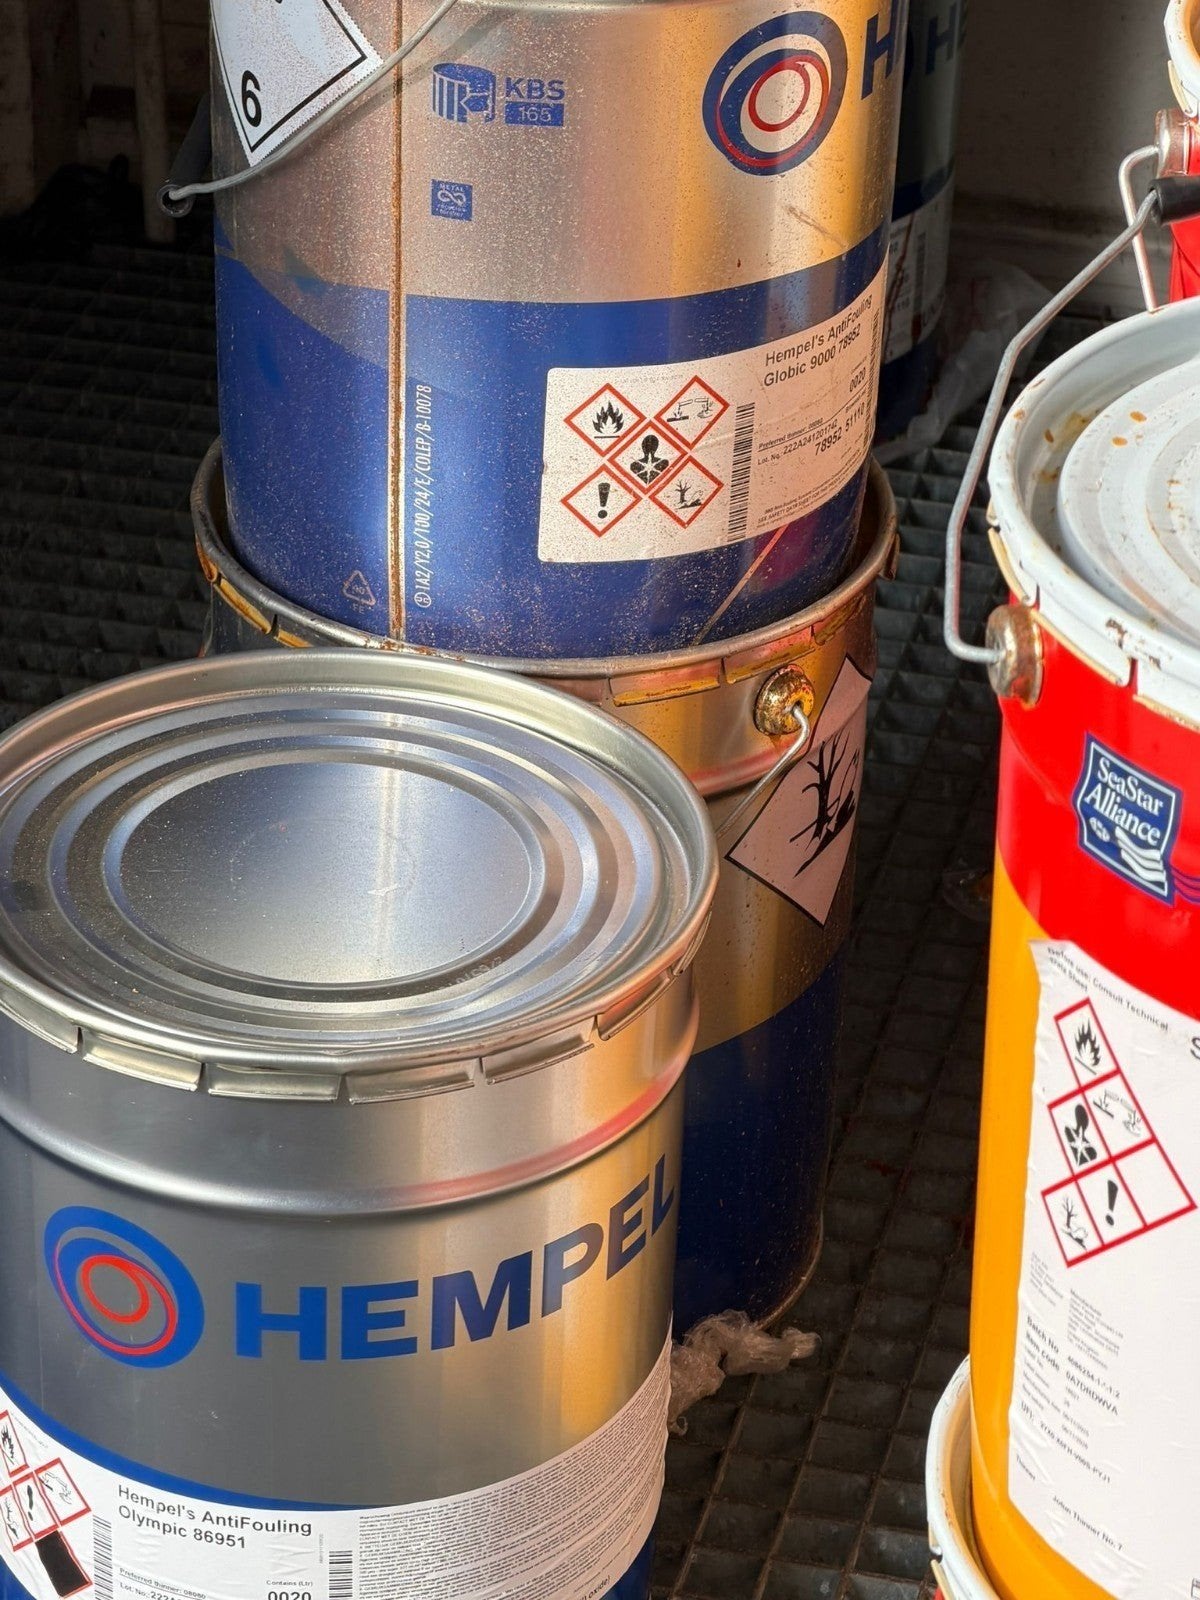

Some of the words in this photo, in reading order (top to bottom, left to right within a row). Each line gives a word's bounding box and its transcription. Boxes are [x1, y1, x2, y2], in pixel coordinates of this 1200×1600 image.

[242, 70, 262, 127] 6
[505, 77, 566, 101] KBS
[518, 105, 552, 122] 165
[765, 334, 825, 367] Hempel's
[827, 294, 873, 342] AntiFouling
[763, 362, 807, 387] Globic
[810, 345, 836, 370] 9000
[838, 323, 861, 354] 78952
[849, 366, 867, 393] 0020
[758, 434, 787, 449] Preferred
[815, 427, 843, 456] 78952
[1097, 756, 1164, 817] SeaStar
[1084, 783, 1162, 845] Alliance
[1093, 977, 1124, 1004] Consult
[1126, 1000, 1169, 1032] Technical
[235, 1153, 675, 1361] HEMPEL
[1027, 1315, 1047, 1343] Batch
[1041, 1350, 1060, 1371] code
[118, 1484, 196, 1521] Hempel's
[201, 1511, 312, 1537] AntiFouling
[118, 1505, 188, 1538] Olympic
[193, 1527, 246, 1549] 86951
[119, 1567, 153, 1585] Preferred
